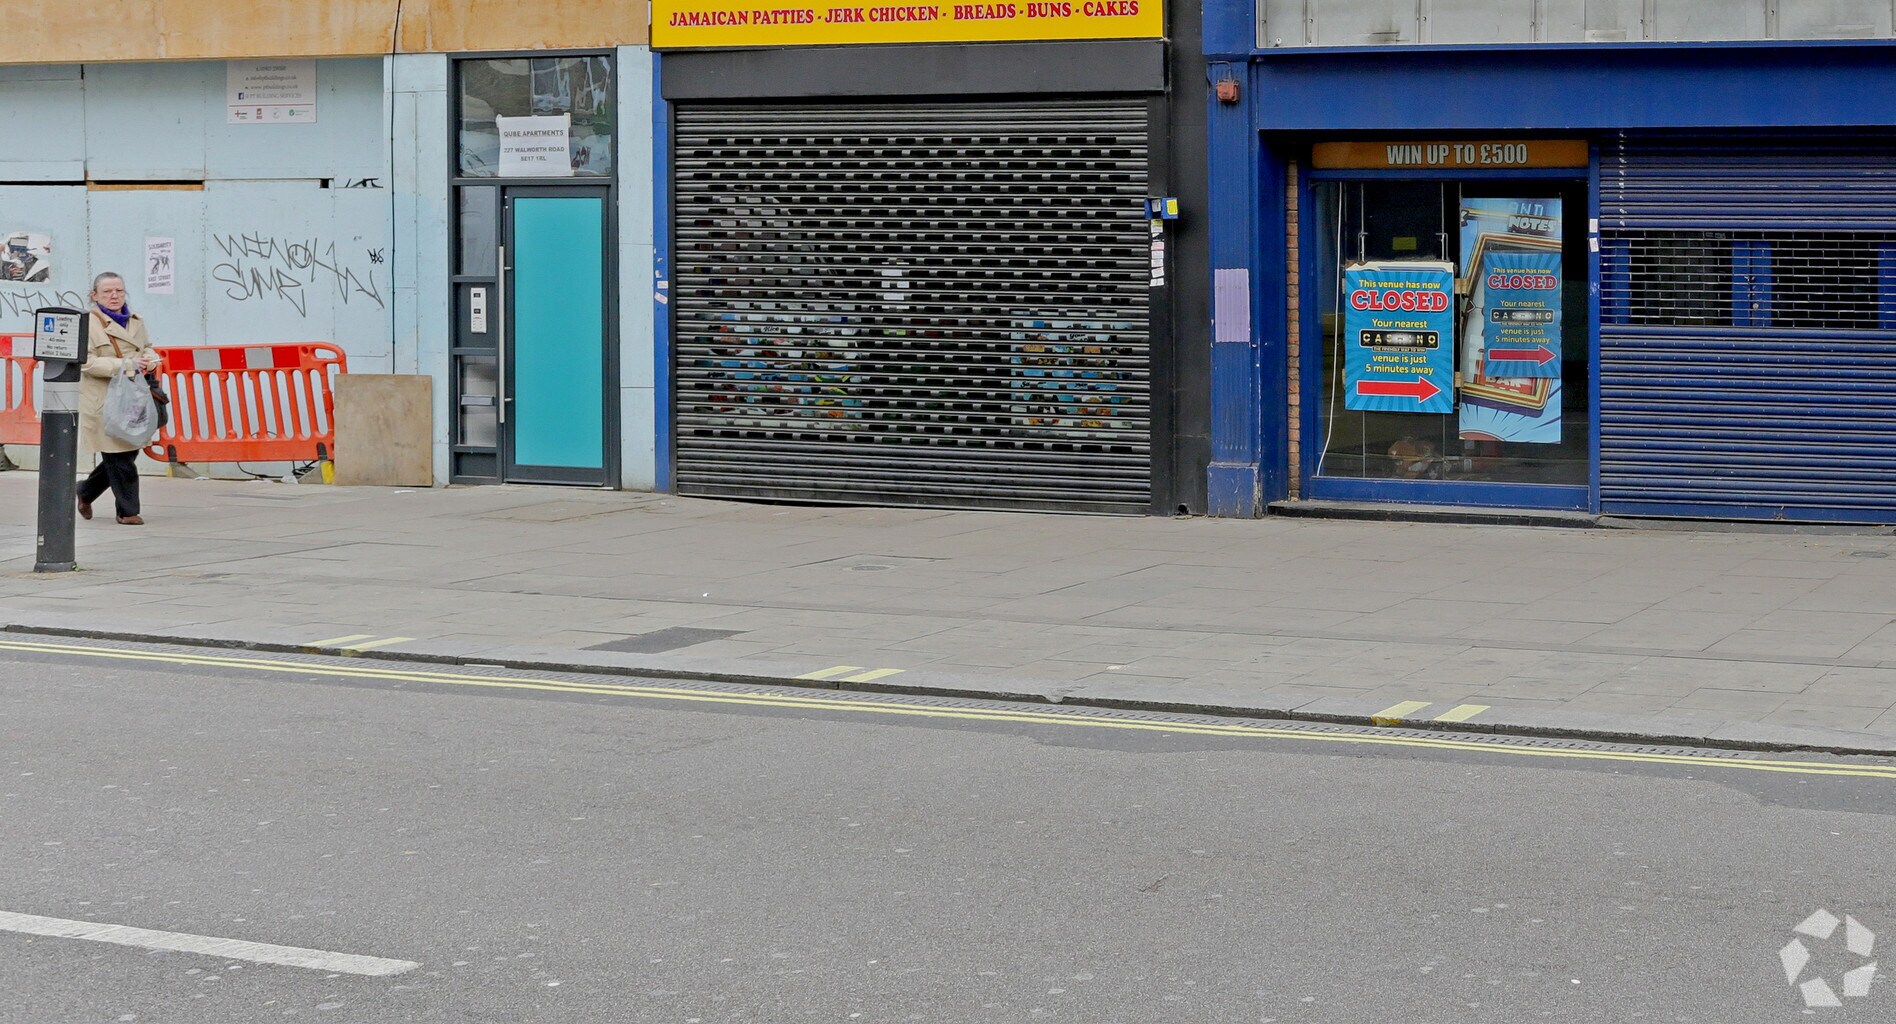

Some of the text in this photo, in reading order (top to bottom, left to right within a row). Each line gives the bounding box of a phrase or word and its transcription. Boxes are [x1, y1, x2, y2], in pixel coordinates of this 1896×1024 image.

[670, 0, 1139, 27] JAMAICAN PATTIES JERK CHICKEN BREADS BUNS CAKES
[1386, 143, 1528, 165] WIN UP TO £500
[1508, 216, 1555, 232] NOTES
[1359, 279, 1376, 287] This
[1406, 280, 1420, 288] has
[1488, 274, 1557, 290] CLOSED
[1351, 290, 1449, 312] CLOSED
[1372, 319, 1427, 328] Your nearest
[1531, 328, 1544, 336] just
[1372, 354, 1427, 364] venue is just
[1366, 364, 1434, 376] 5 minutes away
